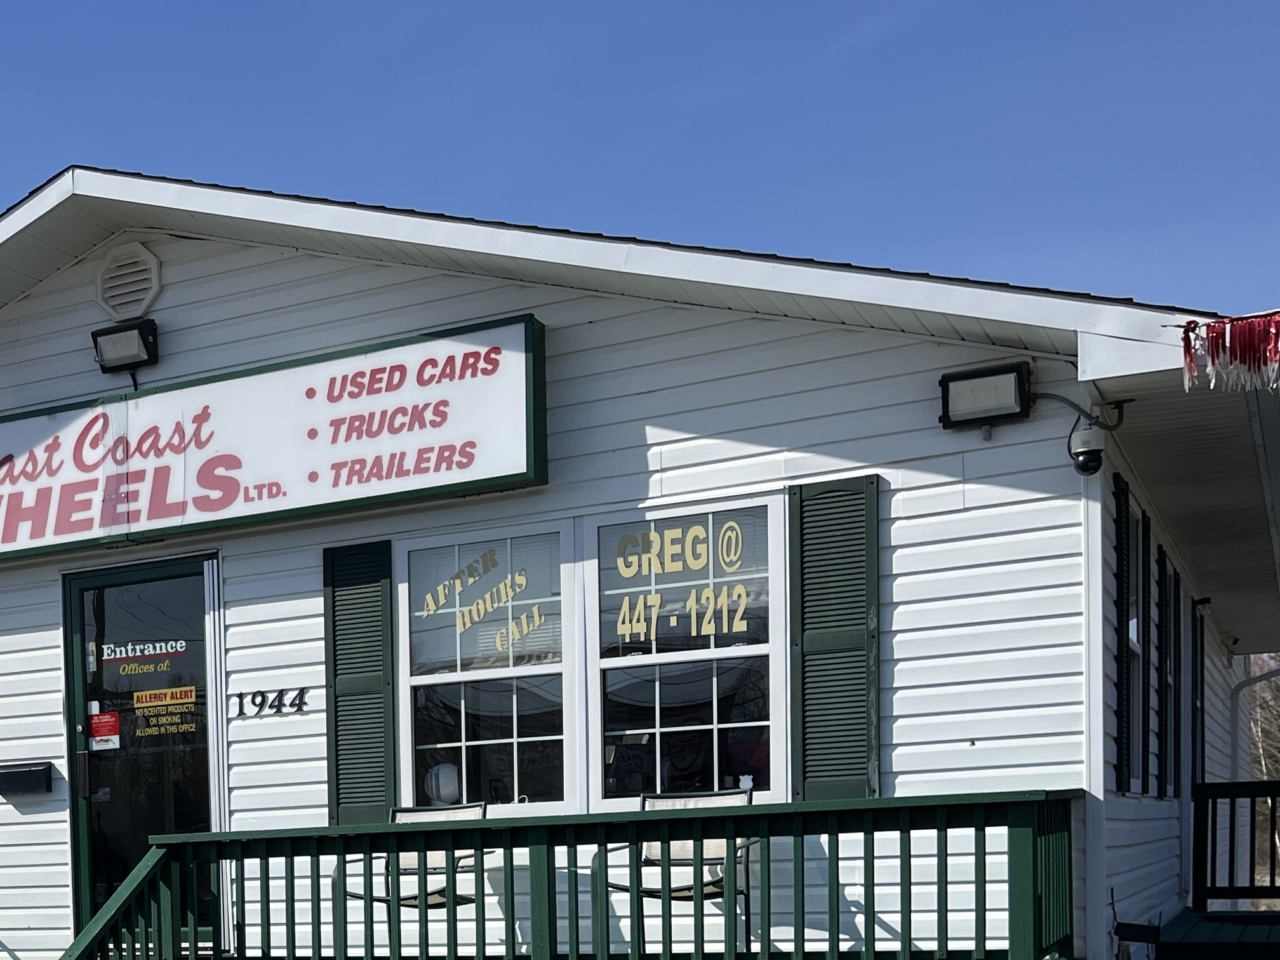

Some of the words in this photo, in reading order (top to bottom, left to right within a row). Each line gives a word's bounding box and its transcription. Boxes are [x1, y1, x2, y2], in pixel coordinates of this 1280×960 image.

[326, 364, 407, 404] USED
[416, 346, 502, 387] CARS
[72, 405, 215, 475] Coast
[329, 399, 449, 444] TRUCKS
[330, 441, 477, 488] TRAILERS
[243, 482, 288, 503] LTD.
[617, 525, 708, 578] GREG
[718, 520, 743, 573] @
[422, 548, 499, 619] AFTER
[457, 567, 528, 634] HOURS
[494, 604, 546, 652] CALL
[102, 640, 186, 660] Entrance
[120, 663, 155, 675] Offices
[135, 709, 144, 717] NO
[144, 706, 167, 716] SCENTED
[167, 703, 195, 714] PRODUCTS
[136, 692, 168, 704] ALLERGY
[170, 689, 194, 701] ALERT
[236, 687, 309, 718] 1944
[136, 727, 160, 737] ALLOWED
[160, 726, 166, 734] IN
[166, 725, 178, 734] THIS
[178, 723, 196, 733] OFFICE
[150, 717, 158, 725] OR
[158, 715, 181, 725] SMOKING
